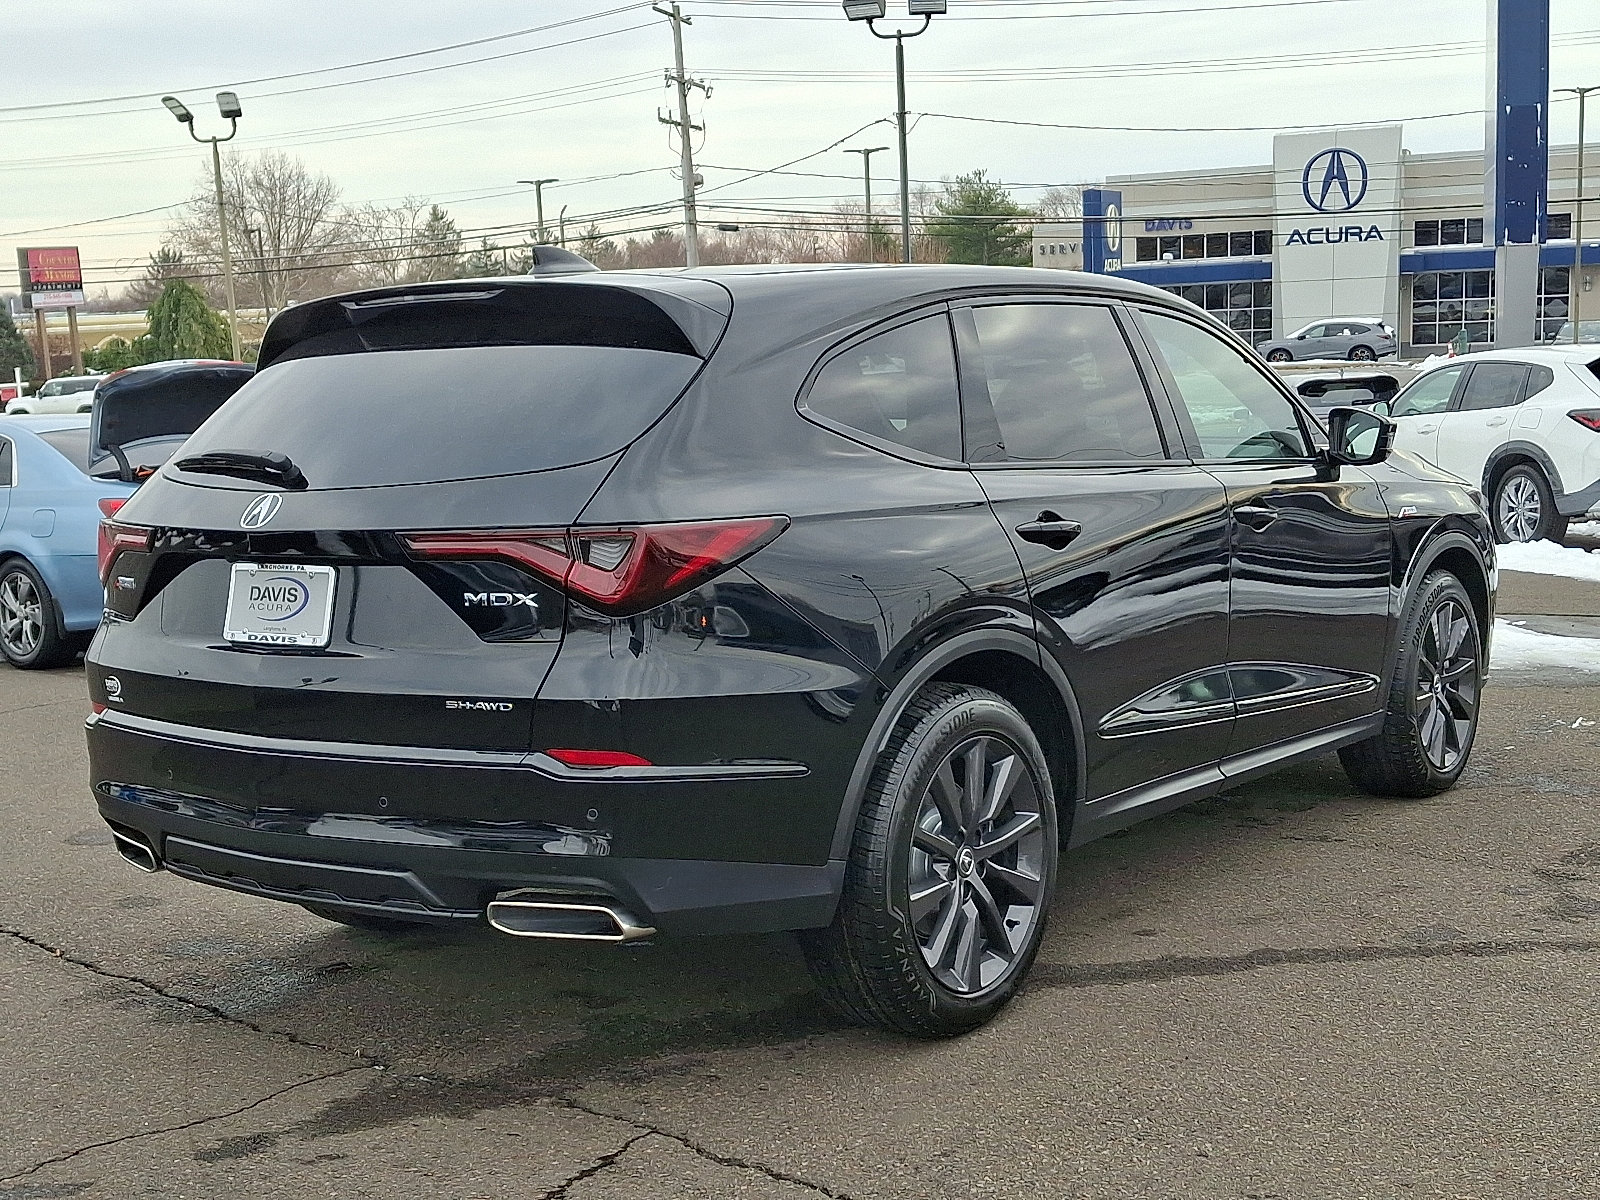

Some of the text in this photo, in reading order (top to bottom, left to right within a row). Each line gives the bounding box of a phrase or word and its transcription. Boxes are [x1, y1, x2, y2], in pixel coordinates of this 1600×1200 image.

[1145, 218, 1193, 232] DAVIS
[1285, 225, 1384, 246] ACURA
[1104, 258, 1121, 272] ACURA
[249, 586, 299, 603] DAVIS
[463, 592, 539, 608] MDX
[248, 602, 292, 612] ACURA
[247, 634, 298, 644] DAVIS
